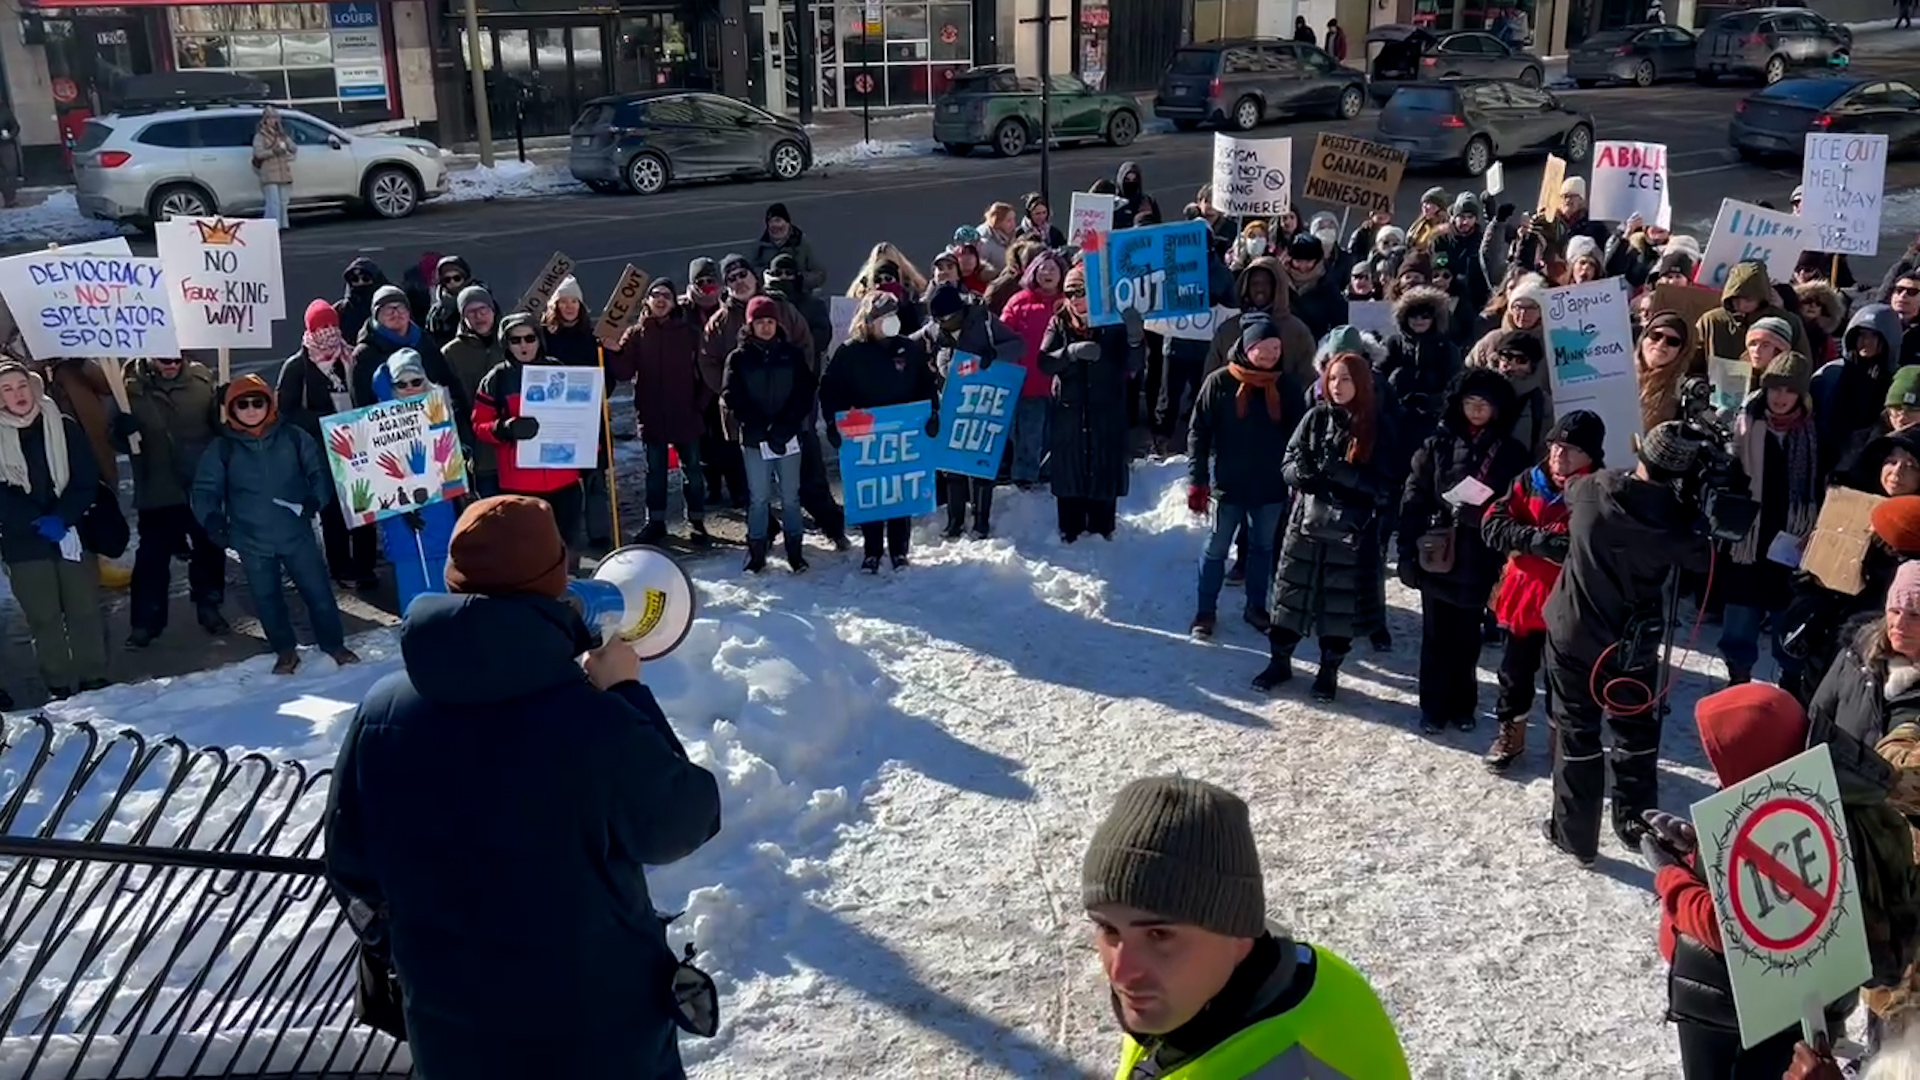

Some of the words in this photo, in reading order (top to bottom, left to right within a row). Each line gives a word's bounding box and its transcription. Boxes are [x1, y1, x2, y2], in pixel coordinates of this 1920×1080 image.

[335, 13, 373, 24] LOUER
[1321, 135, 1360, 152] RESIST
[1810, 138, 1841, 160] ICE
[1845, 139, 1884, 162] OUT
[1322, 152, 1388, 182] CANADA
[1596, 146, 1664, 170] ABOLI
[1238, 165, 1267, 178] NOT
[1628, 172, 1662, 191] ICE
[1306, 176, 1390, 212] MINNESOTA
[1823, 191, 1877, 208] AWAY
[1729, 209, 1742, 233] I
[1744, 214, 1781, 236] LIKE
[204, 250, 238, 274] NO
[1741, 242, 1773, 261] ICE
[28, 260, 164, 289] DEMOCRACY
[537, 258, 571, 296] KINGS
[75, 284, 127, 305] NOT
[605, 301, 630, 328] ICE
[621, 269, 643, 298] OUT
[1115, 270, 1167, 315] OUT
[1178, 284, 1204, 297] MTL
[40, 305, 166, 328] SPECTATOR
[1549, 290, 1614, 321] J'appuie
[204, 304, 255, 333] WAY!
[1578, 318, 1597, 337] le
[59, 328, 148, 349] SPORT
[367, 408, 388, 422] USA
[390, 399, 425, 416] CRIMES
[956, 384, 1010, 417] ICE
[379, 413, 419, 432] AGAINST
[372, 424, 422, 447] HUMANITY
[852, 429, 921, 466] ICE
[949, 418, 1003, 453] OUT
[856, 470, 927, 510] OUT
[1744, 827, 1823, 919] ICE
